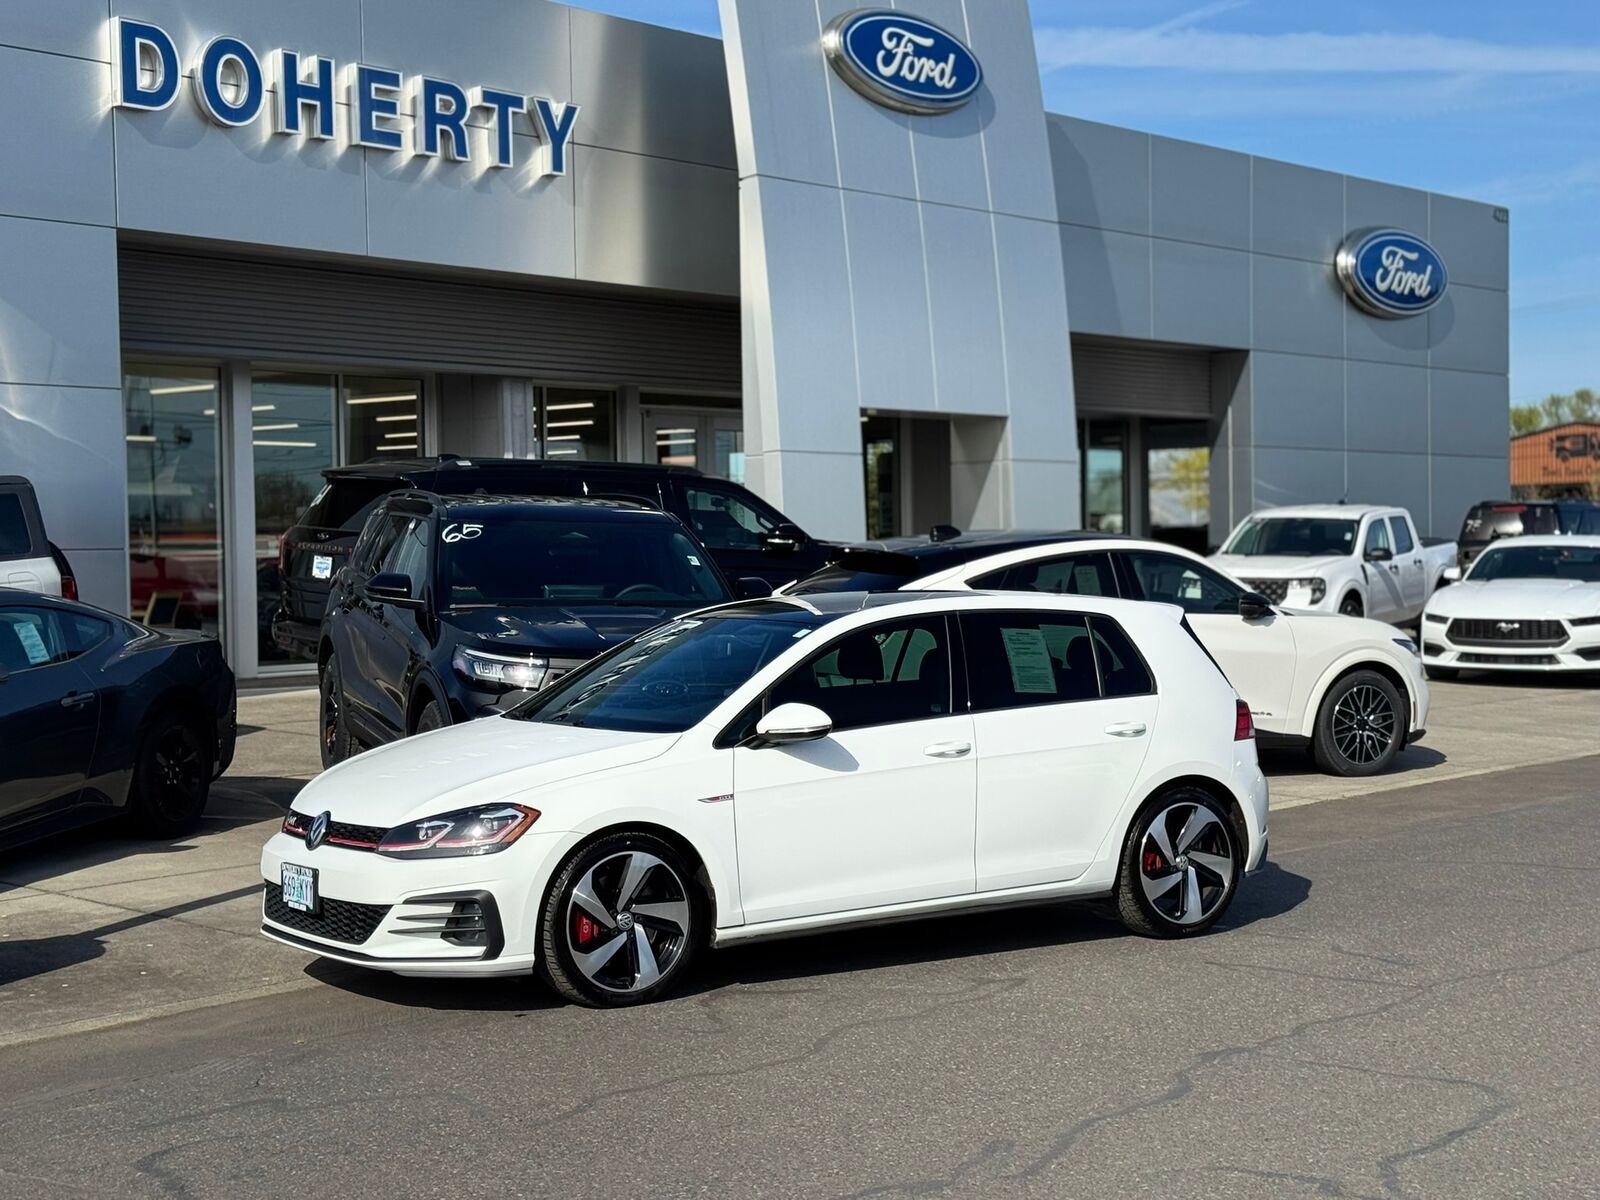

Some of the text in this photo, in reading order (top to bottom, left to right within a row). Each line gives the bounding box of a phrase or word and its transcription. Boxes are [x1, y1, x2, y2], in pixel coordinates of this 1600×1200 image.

[876, 26, 957, 90] Ford
[112, 16, 581, 177] DOHERTY
[1375, 245, 1432, 299] Ford
[441, 523, 484, 543] 65
